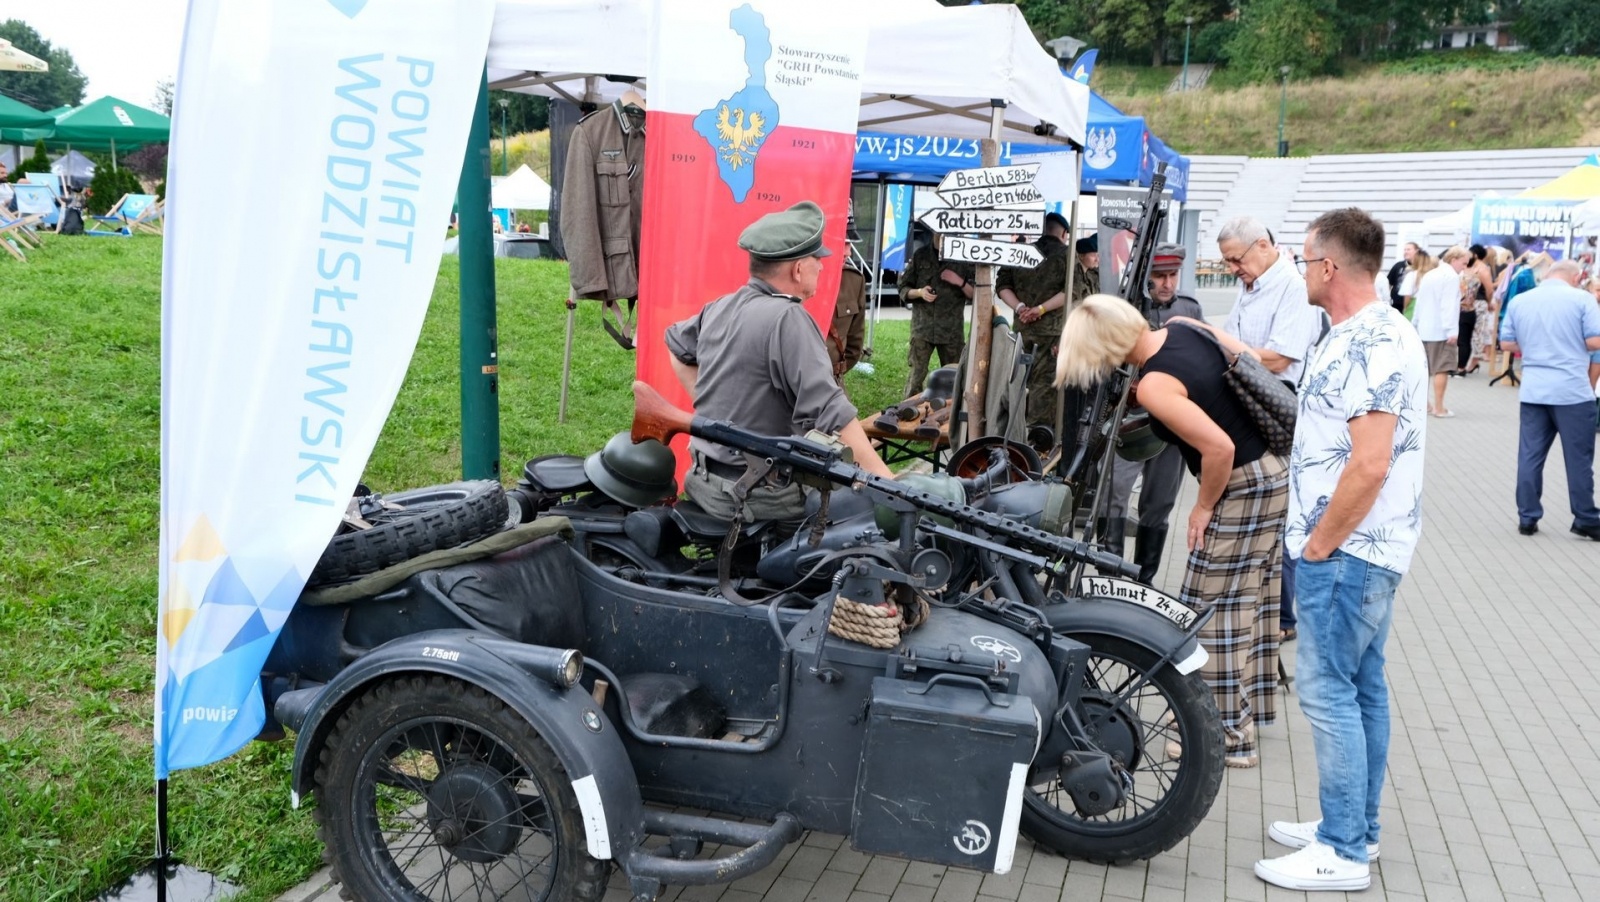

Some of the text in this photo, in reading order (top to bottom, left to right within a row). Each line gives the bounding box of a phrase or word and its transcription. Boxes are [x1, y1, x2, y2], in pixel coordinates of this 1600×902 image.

[778, 45, 850, 64] Stowarzyszenie
[775, 71, 812, 86] Śląski"
[814, 64, 859, 80] Powstaniec
[791, 139, 815, 149] 1921
[376, 56, 434, 264] POWIAT
[671, 153, 696, 163] 1919
[956, 170, 1005, 187] Berlin
[757, 192, 781, 202] 1920
[952, 188, 1014, 207] Dresden
[936, 211, 1004, 230] Ratibor
[1479, 220, 1515, 235] RAJD
[949, 240, 1003, 262] Pless
[294, 53, 384, 507] WODZISŁAWSKI
[1089, 578, 1148, 602] helmut
[183, 706, 239, 724] powia
